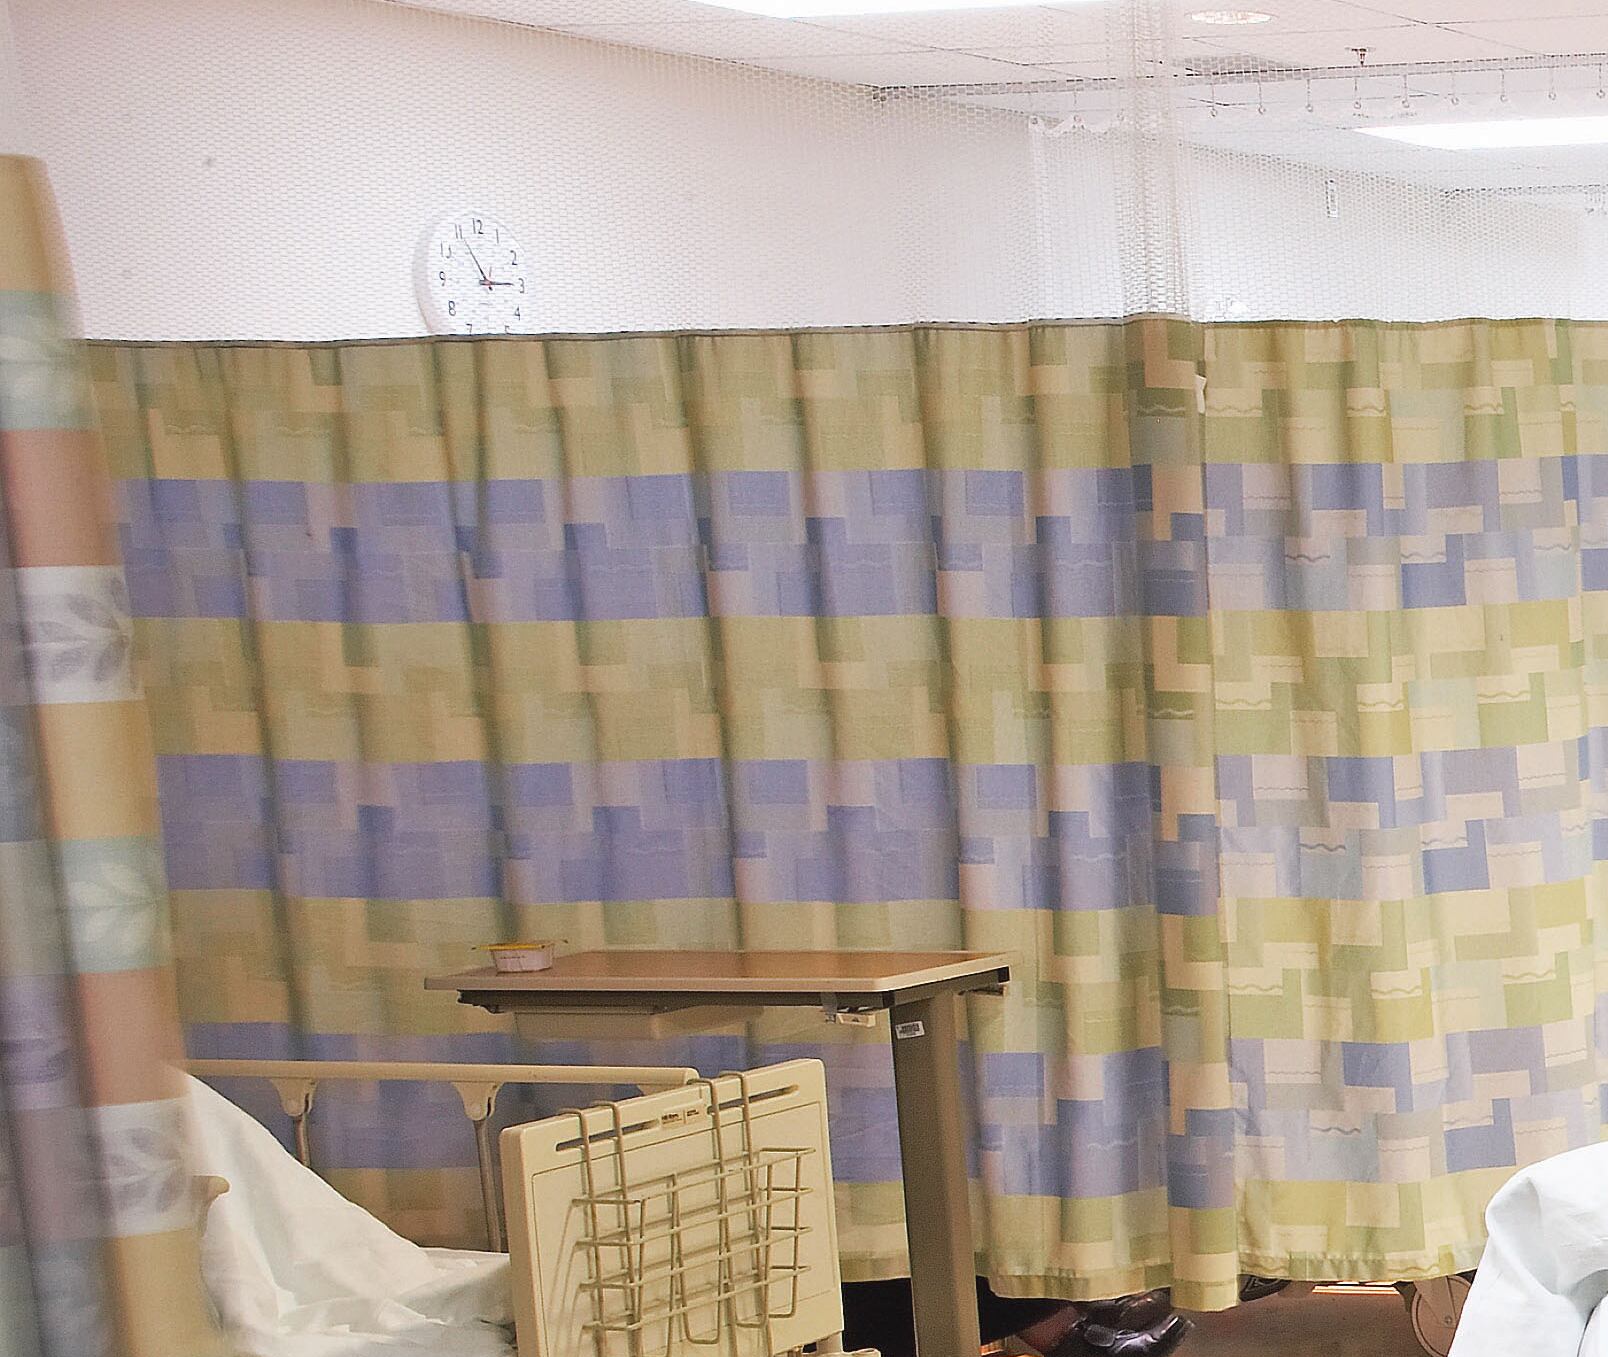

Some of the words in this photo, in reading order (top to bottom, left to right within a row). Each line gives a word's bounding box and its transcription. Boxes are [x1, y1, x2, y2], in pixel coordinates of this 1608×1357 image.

[454, 223, 463, 240] 11
[471, 217, 484, 235] 12
[495, 228, 500, 244] 1
[510, 249, 518, 266] 2
[438, 270, 446, 287] 9
[518, 277, 525, 294] 3
[448, 300, 457, 317] 8
[514, 305, 521, 321] 4
